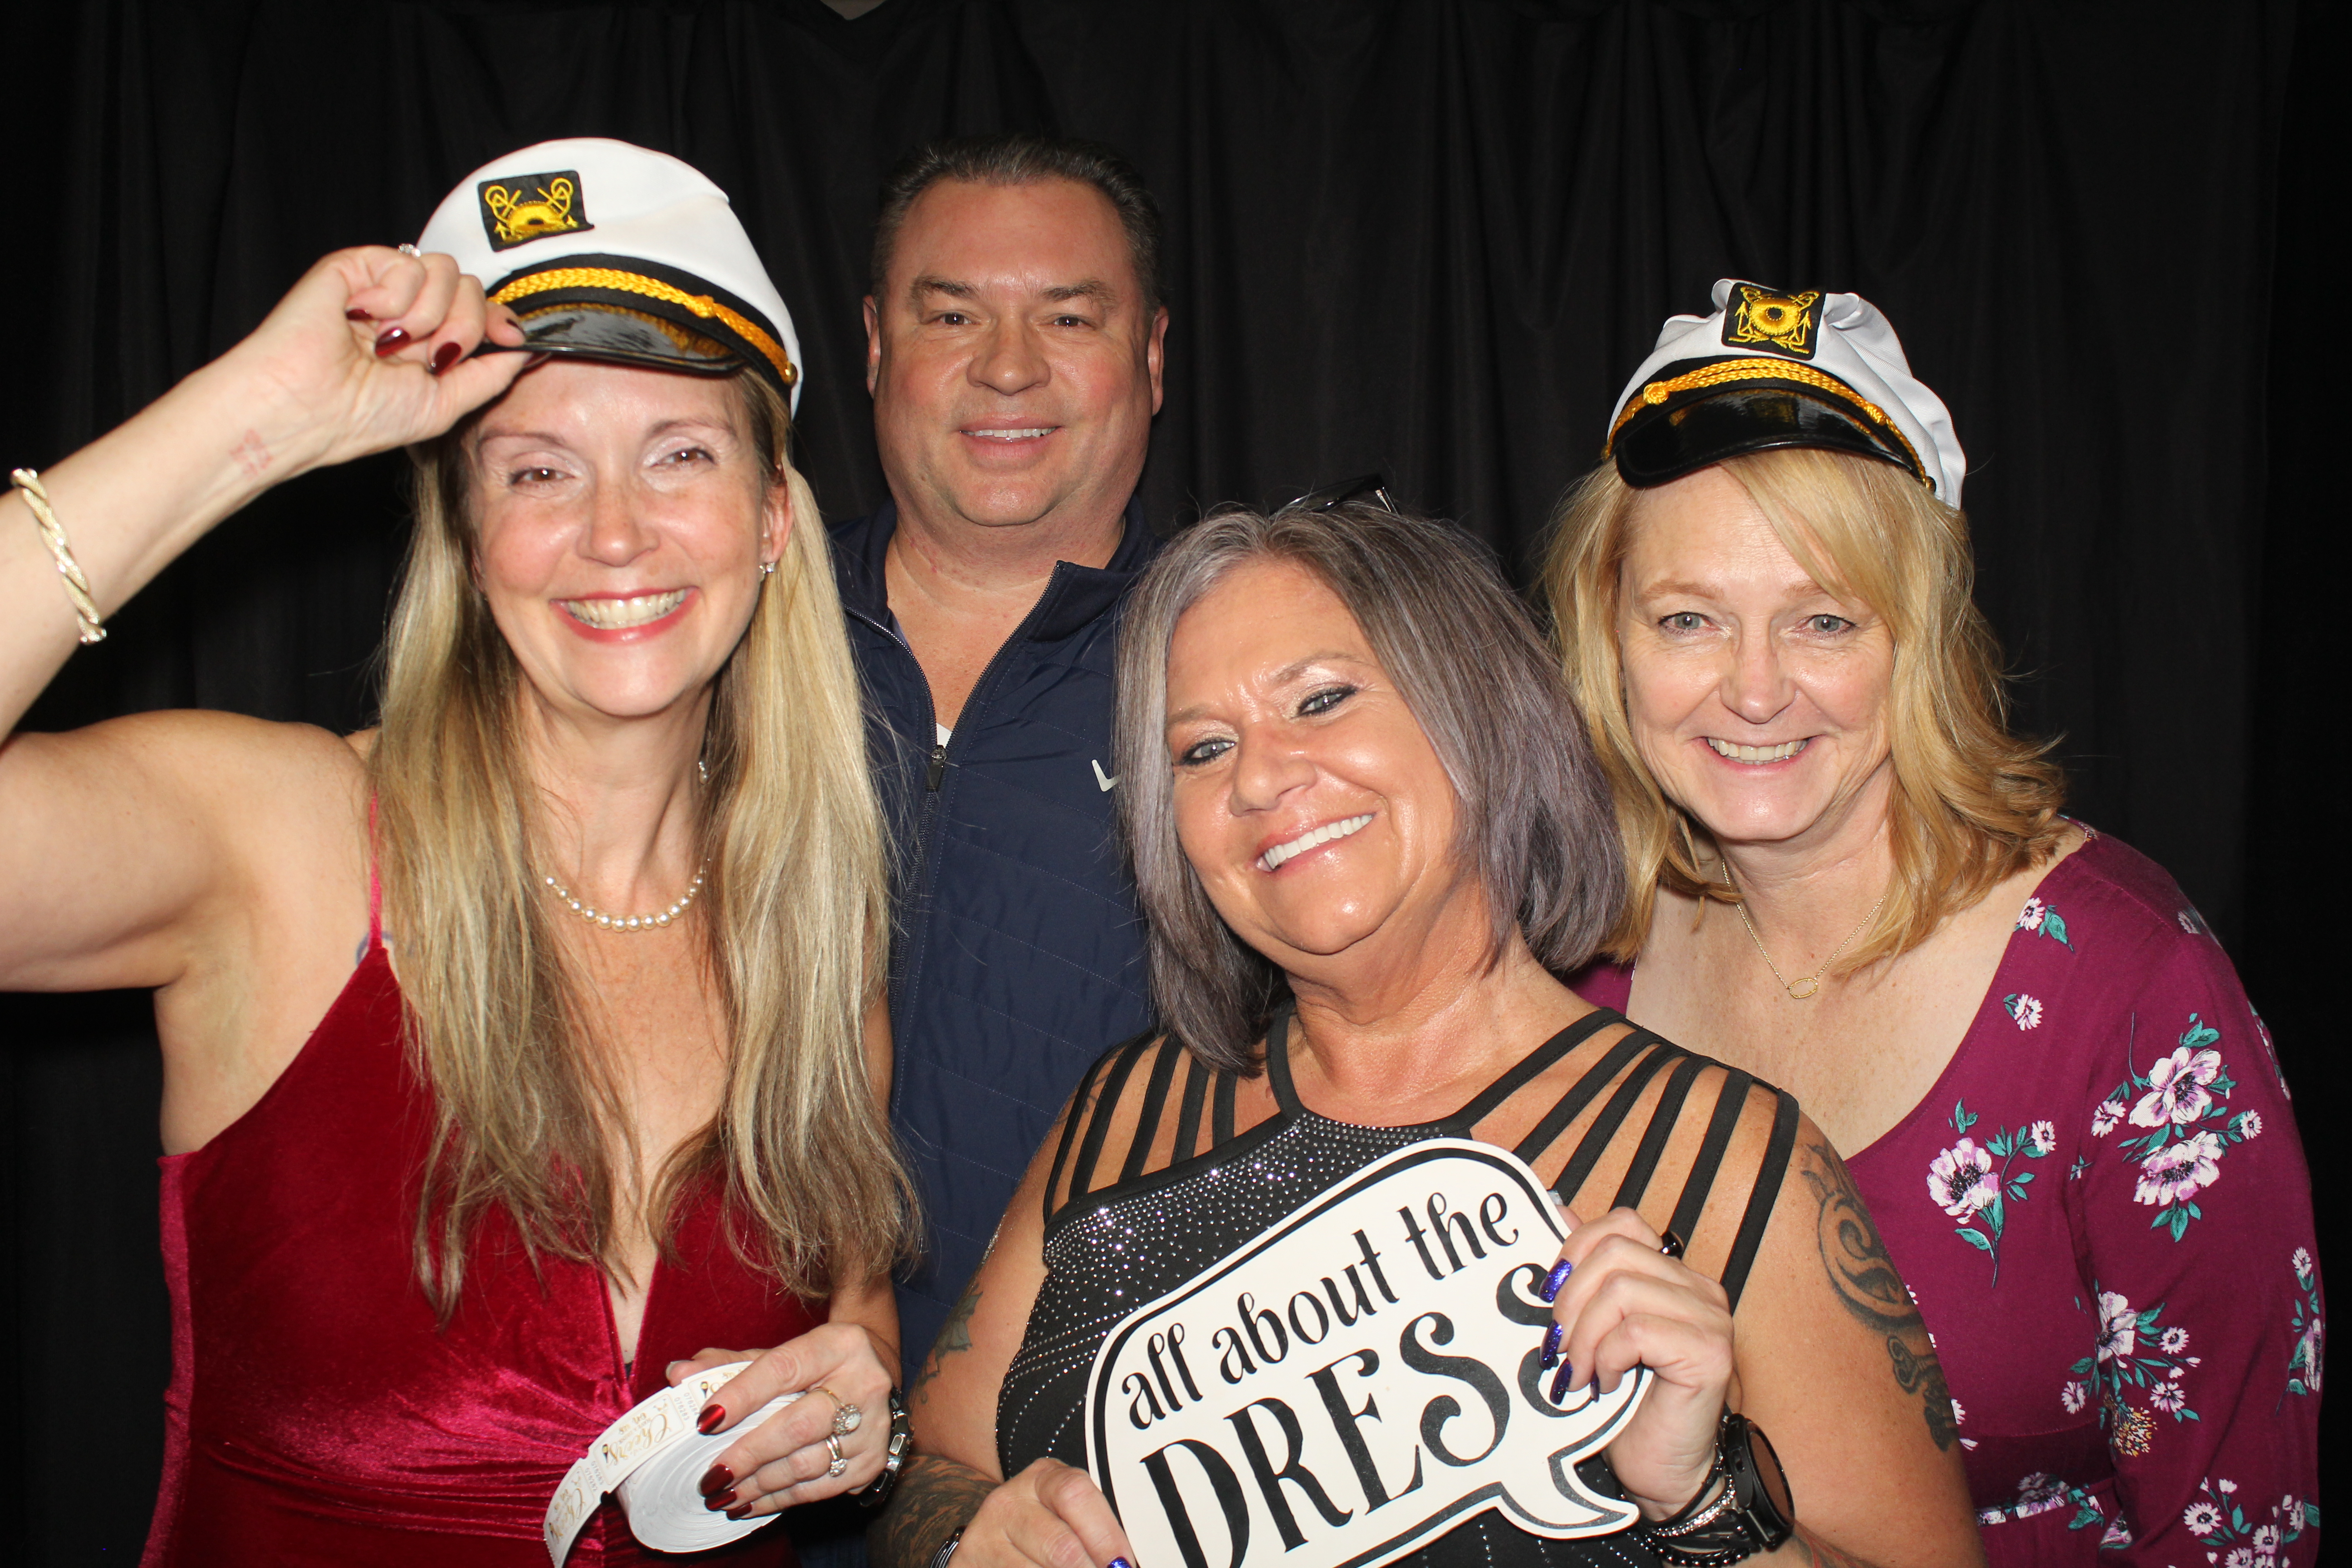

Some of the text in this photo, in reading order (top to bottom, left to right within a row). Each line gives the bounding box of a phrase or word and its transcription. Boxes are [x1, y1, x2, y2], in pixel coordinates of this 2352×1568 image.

[1122, 1192, 1518, 1430] all about the
[674, 1396, 689, 1421] 076283
[609, 1414, 671, 1467] Cheers
